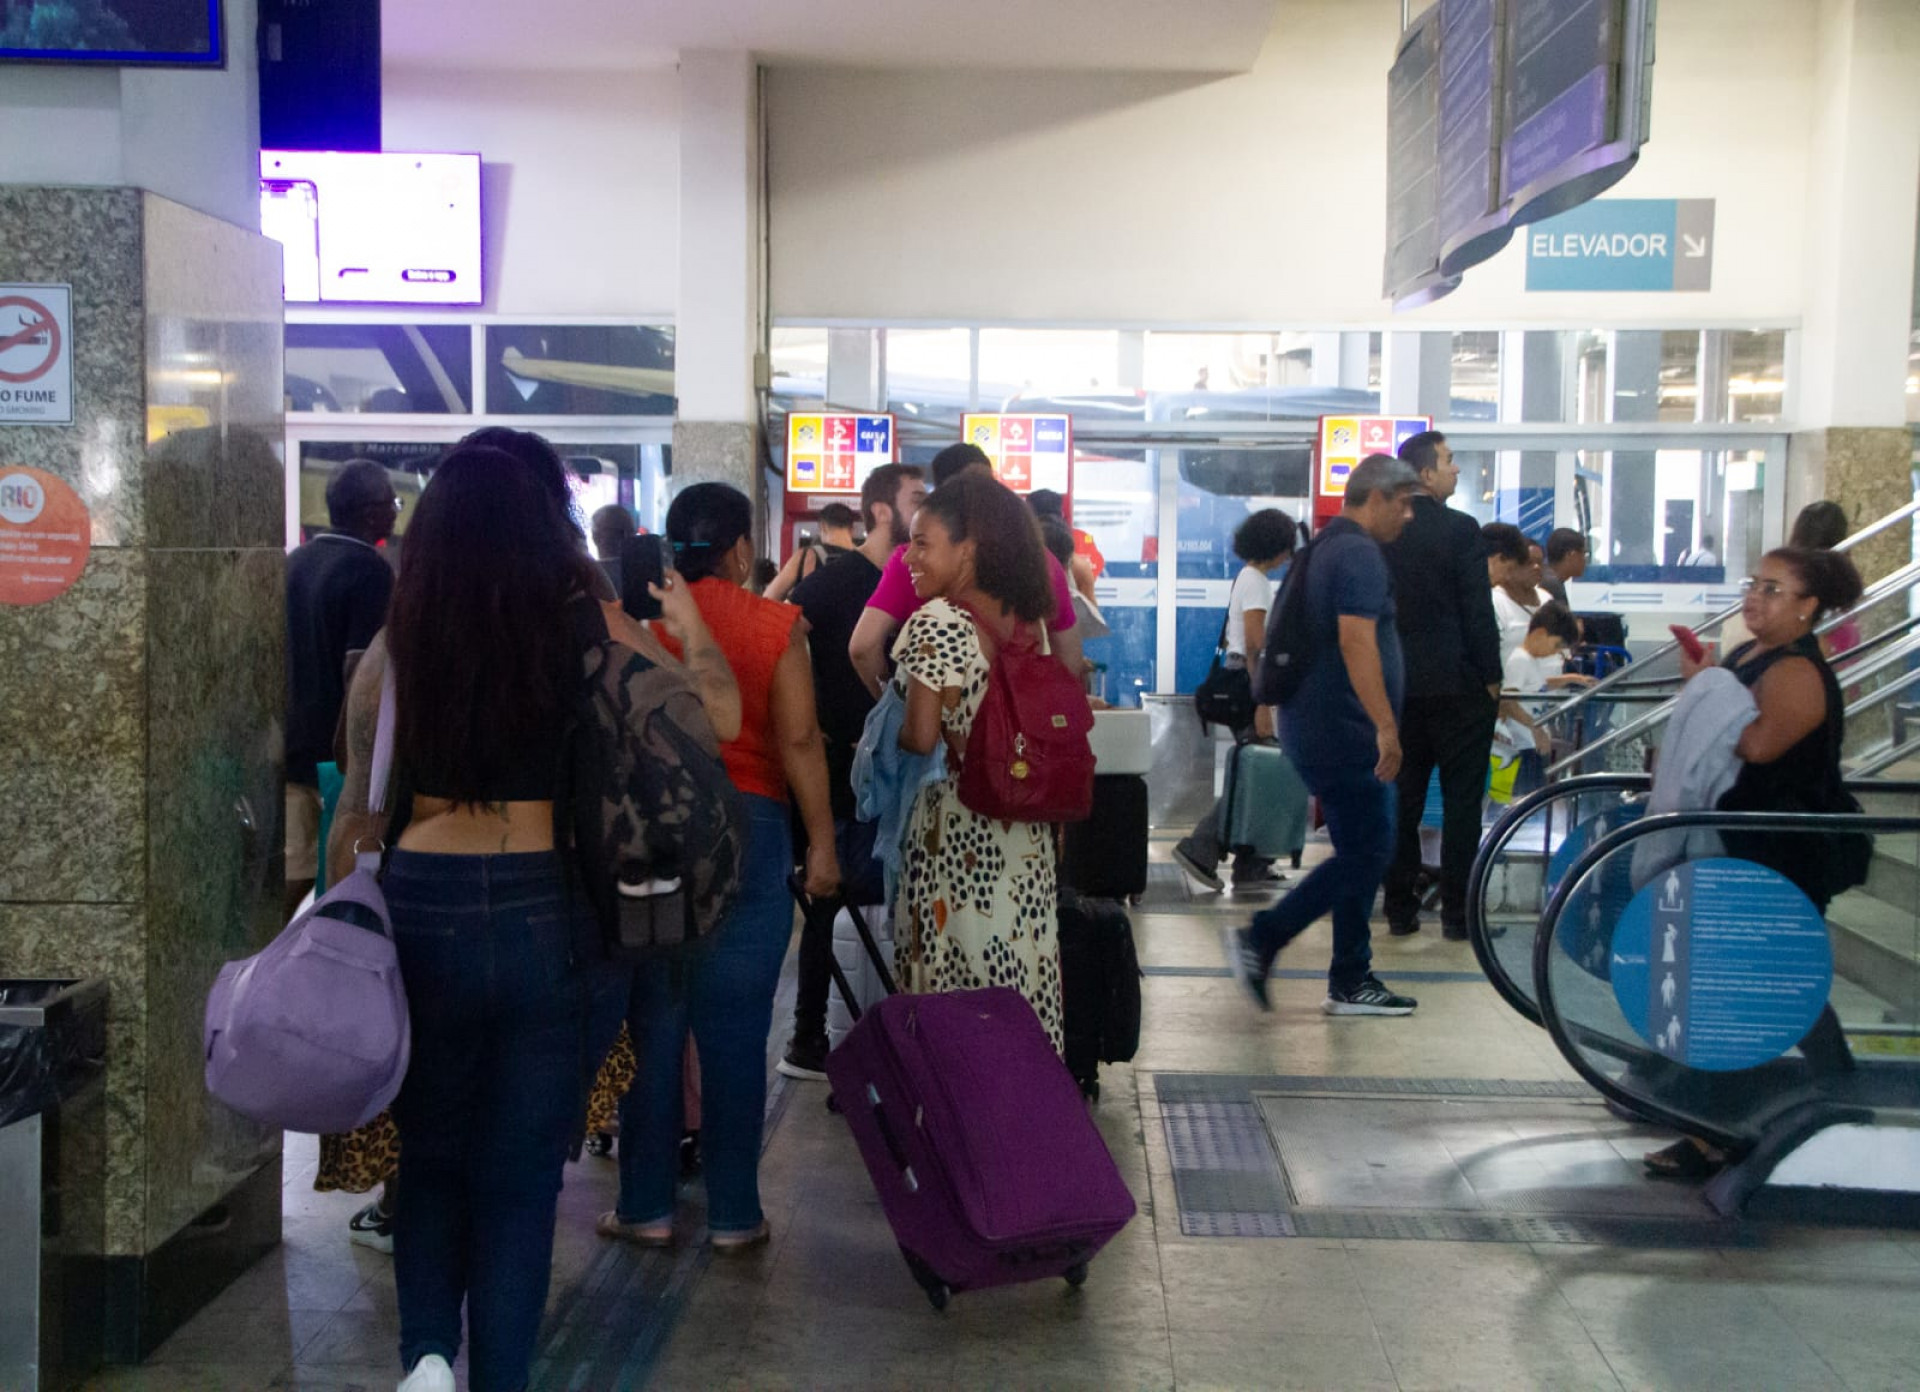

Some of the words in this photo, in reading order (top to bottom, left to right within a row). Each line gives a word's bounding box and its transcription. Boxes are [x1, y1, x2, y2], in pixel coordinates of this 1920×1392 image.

[1532, 233, 1667, 257] ELEVADOR
[15, 390, 56, 403] FUME
[1, 484, 38, 510] RIO
